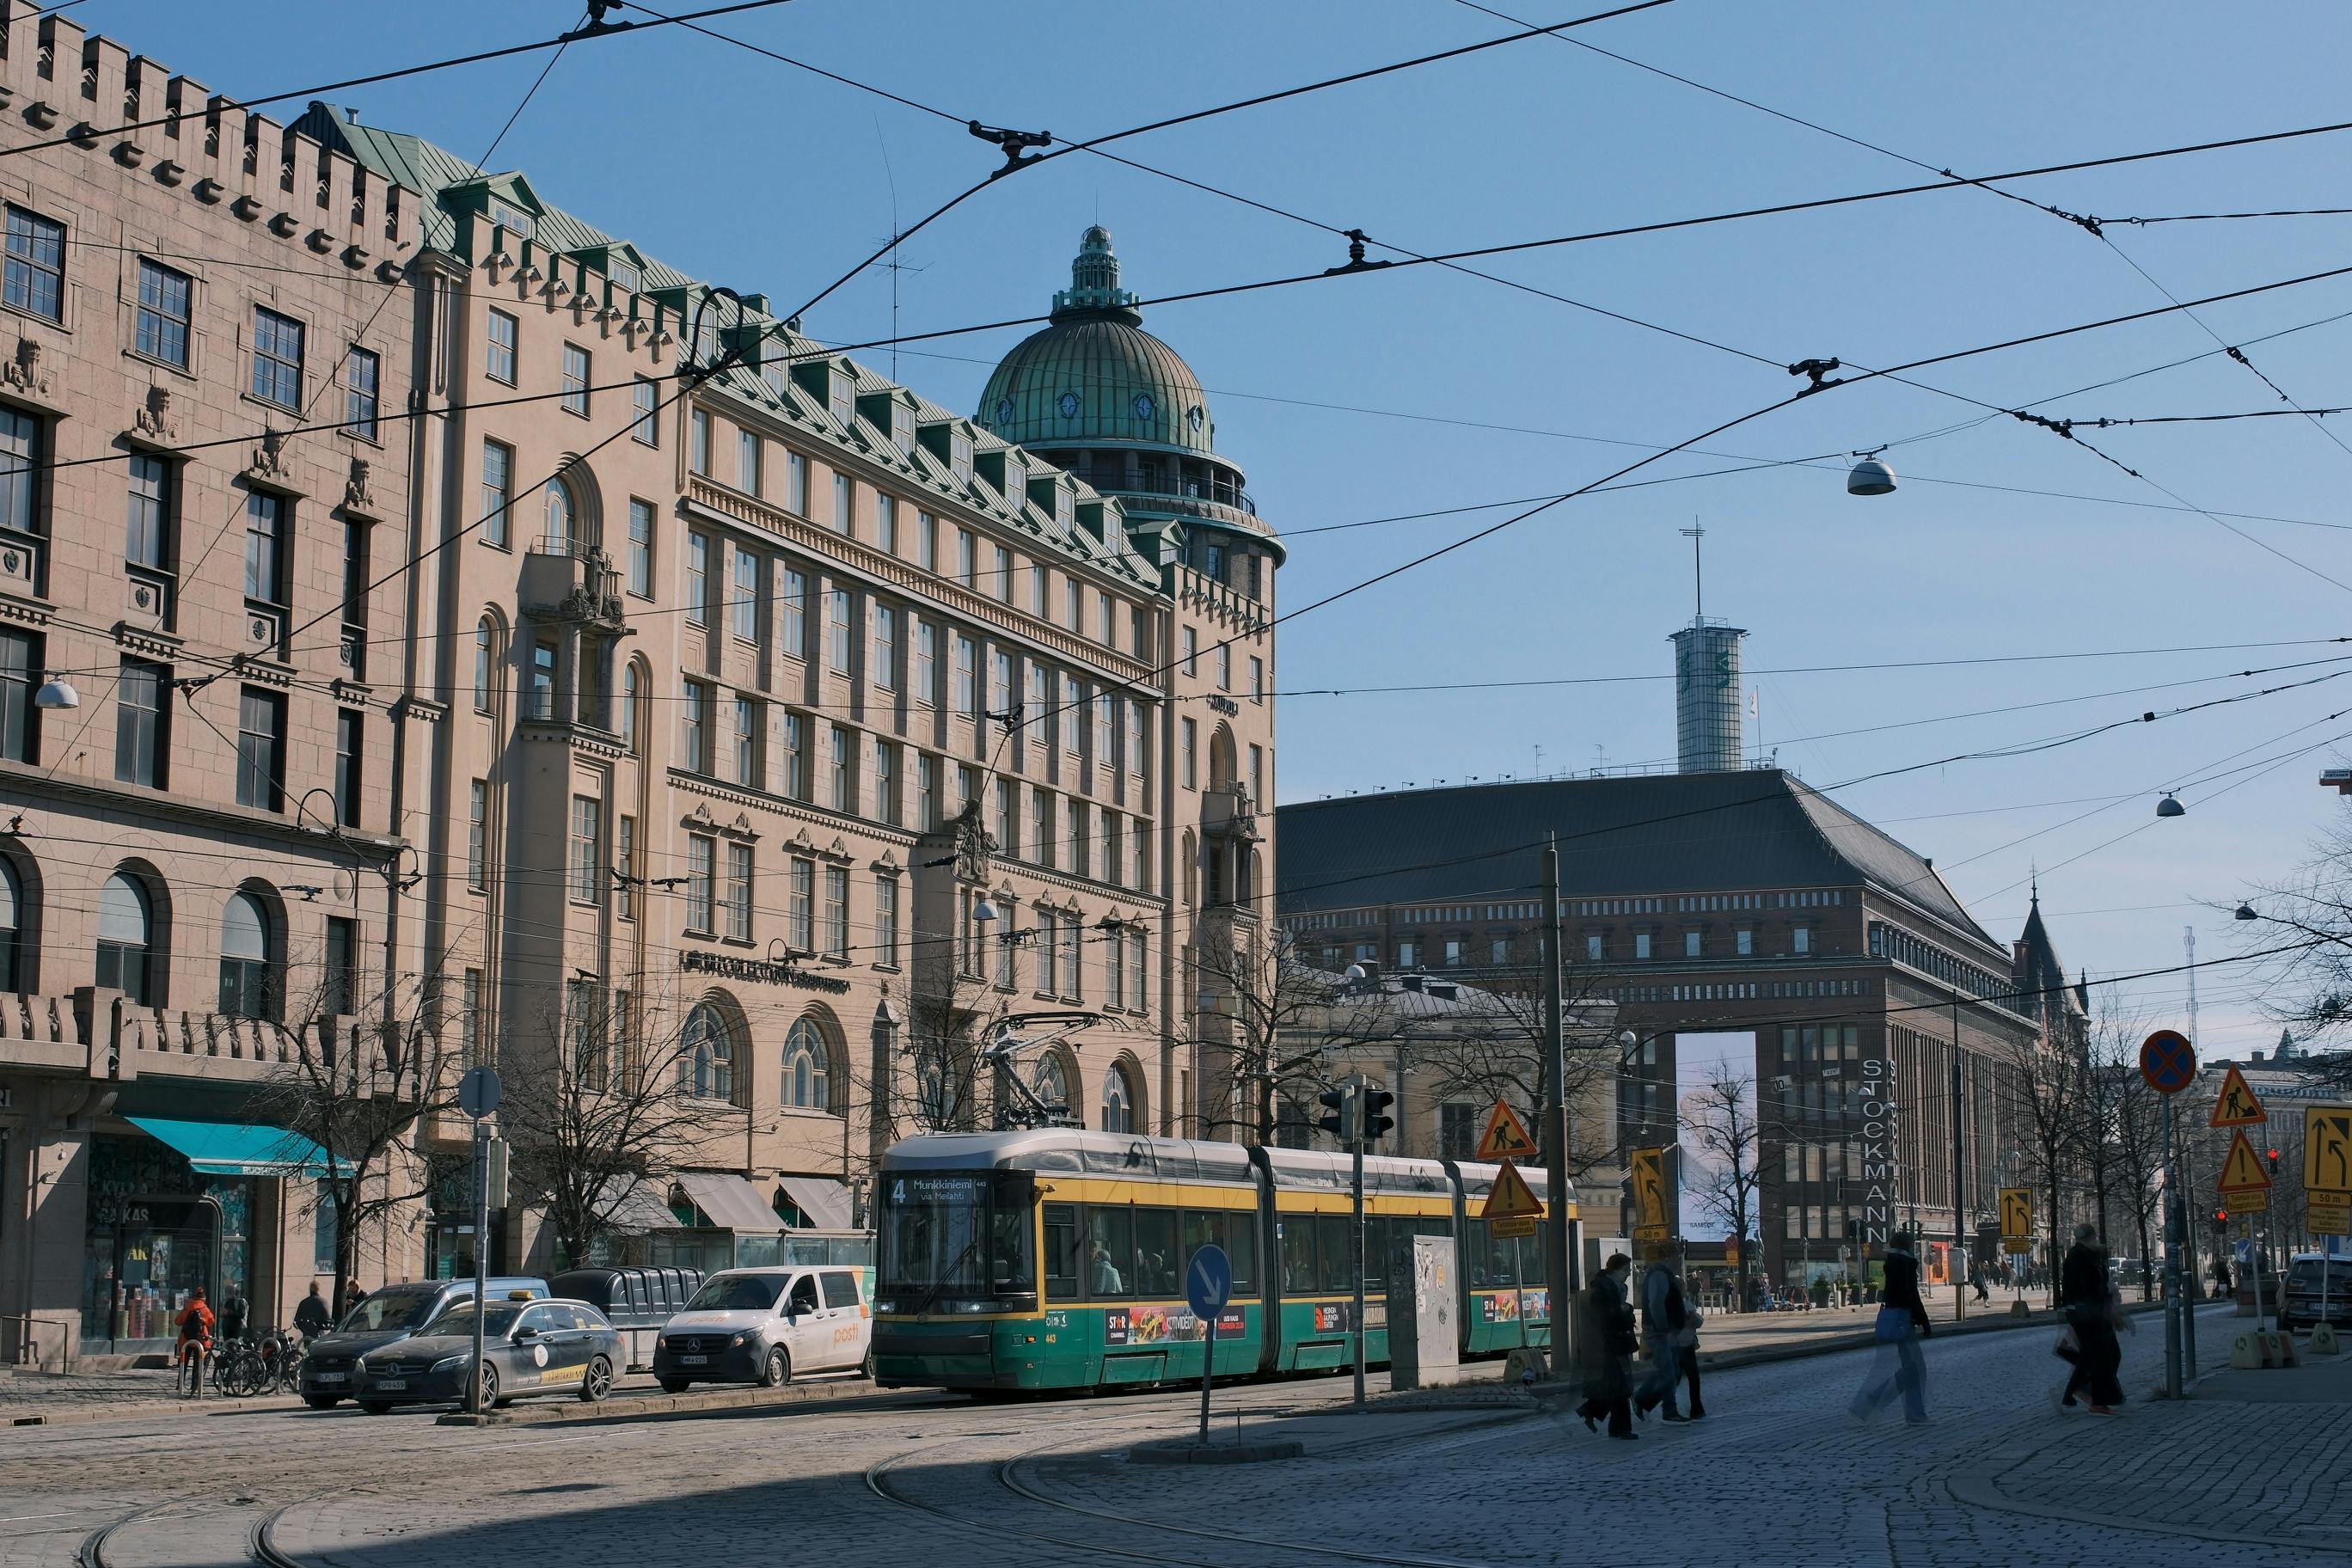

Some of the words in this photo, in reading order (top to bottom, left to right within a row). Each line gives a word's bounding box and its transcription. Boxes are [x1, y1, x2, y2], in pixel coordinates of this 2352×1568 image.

[1863, 1059, 1887, 1243] STOCKMANN
[892, 1179, 906, 1204] 4
[914, 1179, 972, 1190] Munkkiniemi
[934, 1191, 965, 1200] Meilahti
[2318, 1193, 2331, 1203] 50
[1643, 1230, 1652, 1239] 50
[833, 1322, 859, 1349] posti
